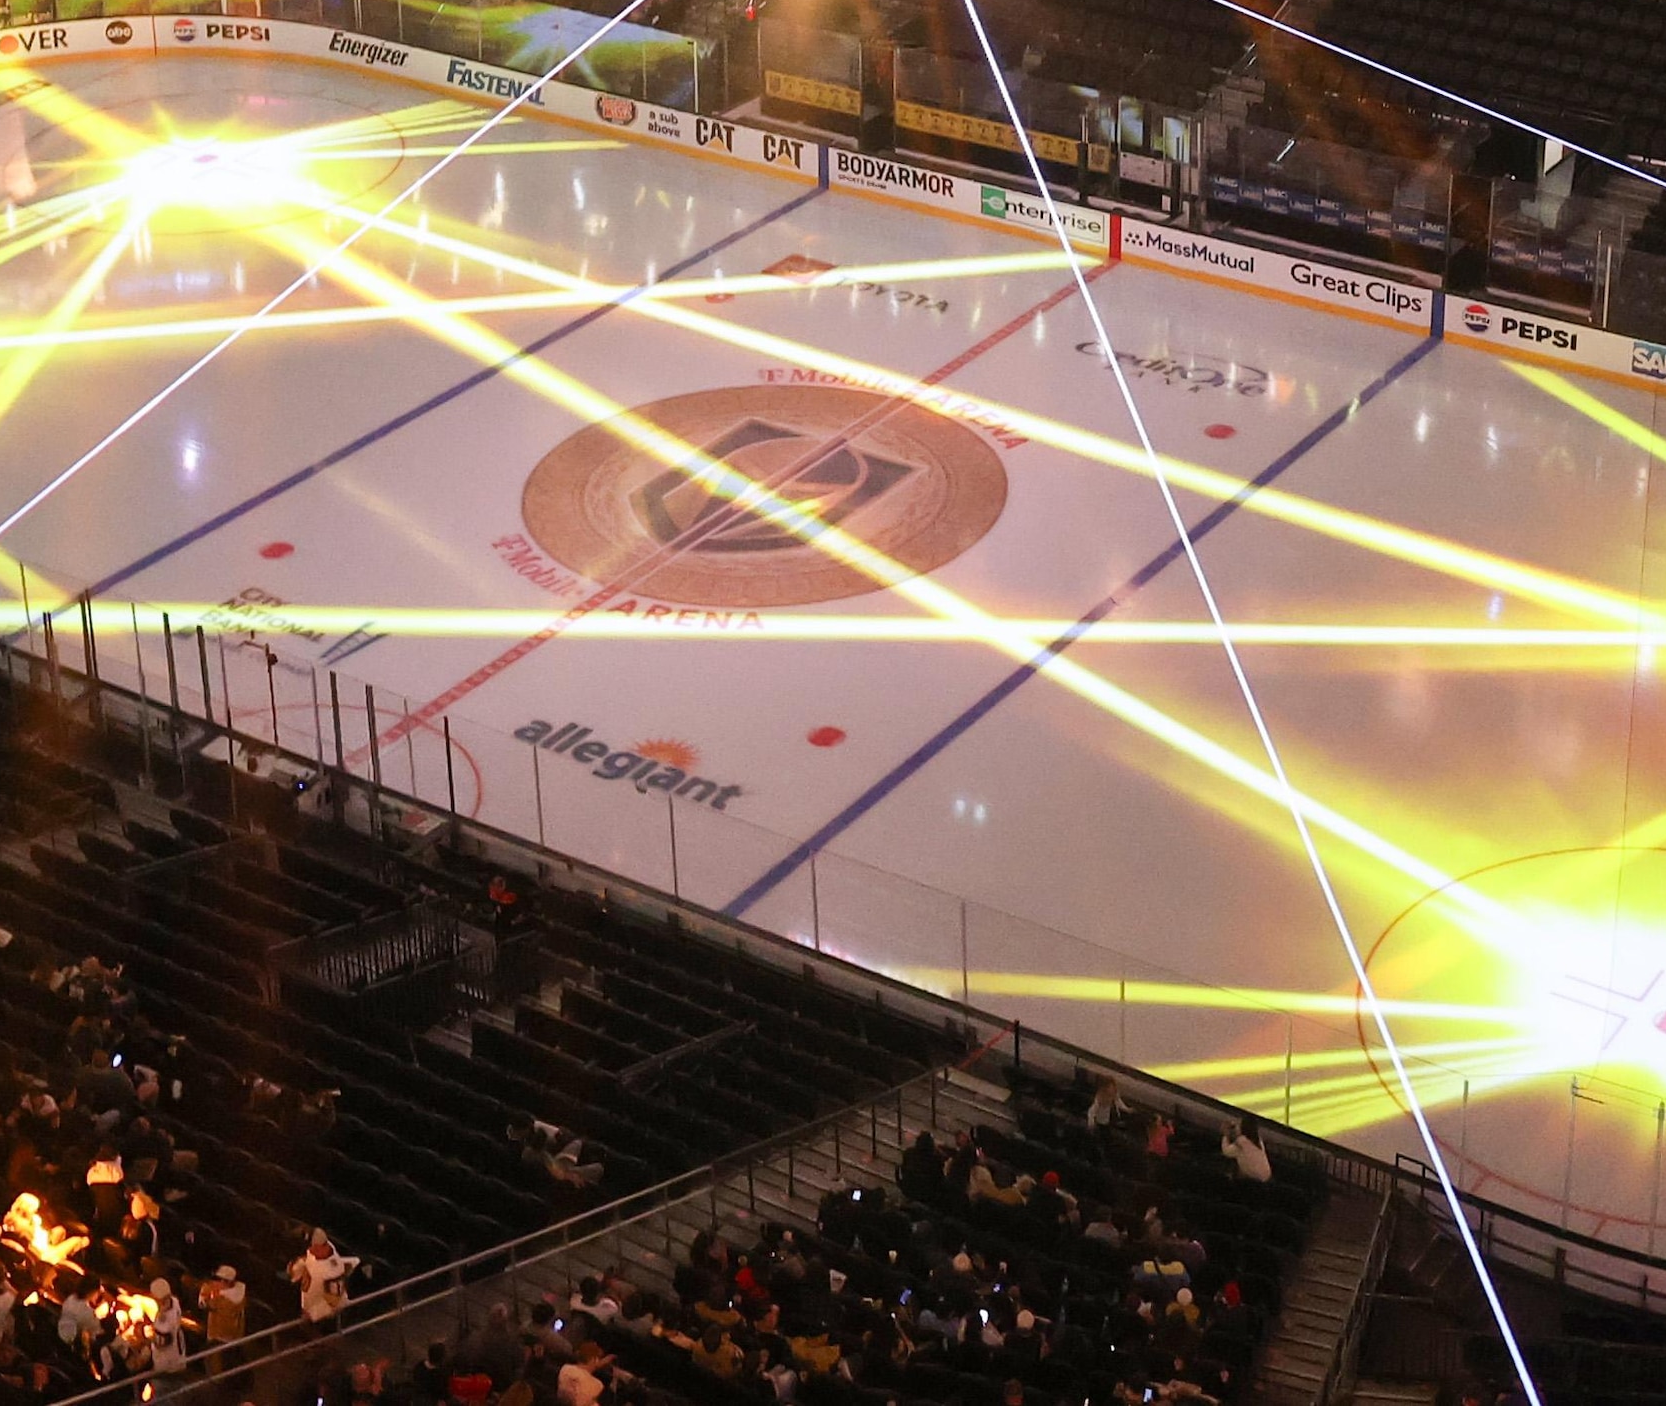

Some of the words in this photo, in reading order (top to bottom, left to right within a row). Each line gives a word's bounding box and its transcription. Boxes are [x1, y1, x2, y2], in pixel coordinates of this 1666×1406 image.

[206, 23, 270, 42] PEPSI
[328, 31, 409, 67] Energizer
[648, 121, 681, 137] above
[659, 112, 678, 125] sub
[696, 118, 735, 153] CAT
[763, 134, 804, 170] CAT
[837, 152, 954, 198] BODYARMOR
[1146, 231, 1255, 274] MassMutual
[1290, 263, 1360, 298] Great
[1366, 281, 1423, 314] Clips
[1463, 313, 1491, 325] PEPSI
[1501, 316, 1578, 351] PEPSI
[604, 599, 765, 630] ARENA
[513, 719, 743, 810] allegiant
